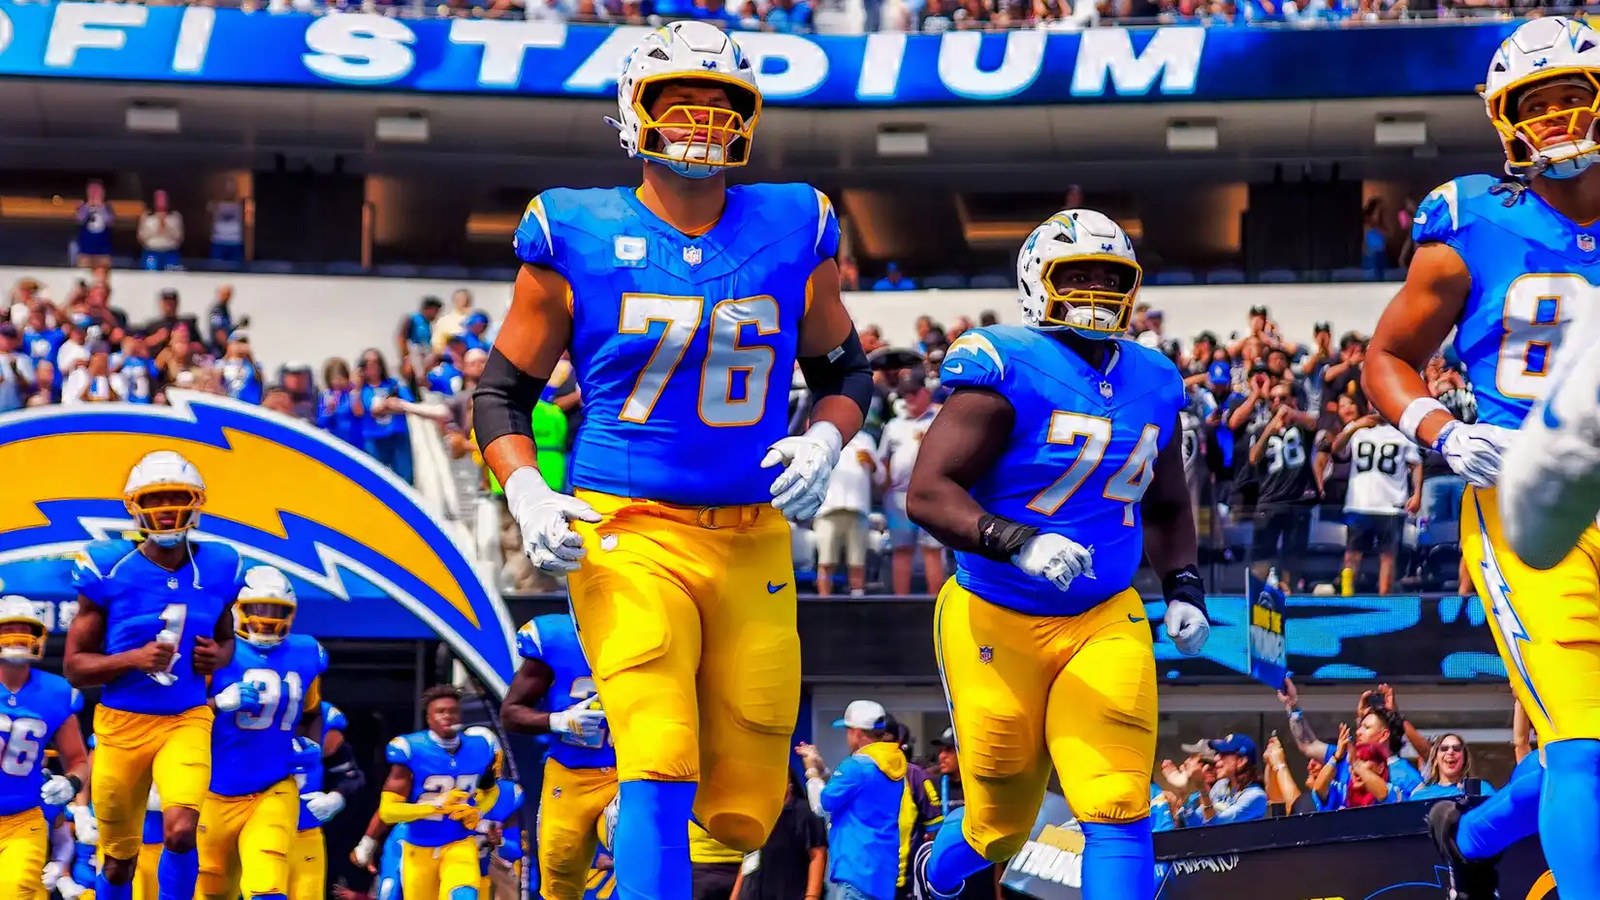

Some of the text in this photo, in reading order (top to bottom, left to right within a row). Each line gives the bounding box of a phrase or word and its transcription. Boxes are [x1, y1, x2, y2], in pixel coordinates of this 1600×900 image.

[0, 0, 216, 74] FI
[617, 292, 781, 428] 76
[1025, 409, 1161, 527] 74
[1356, 441, 1399, 475] 98
